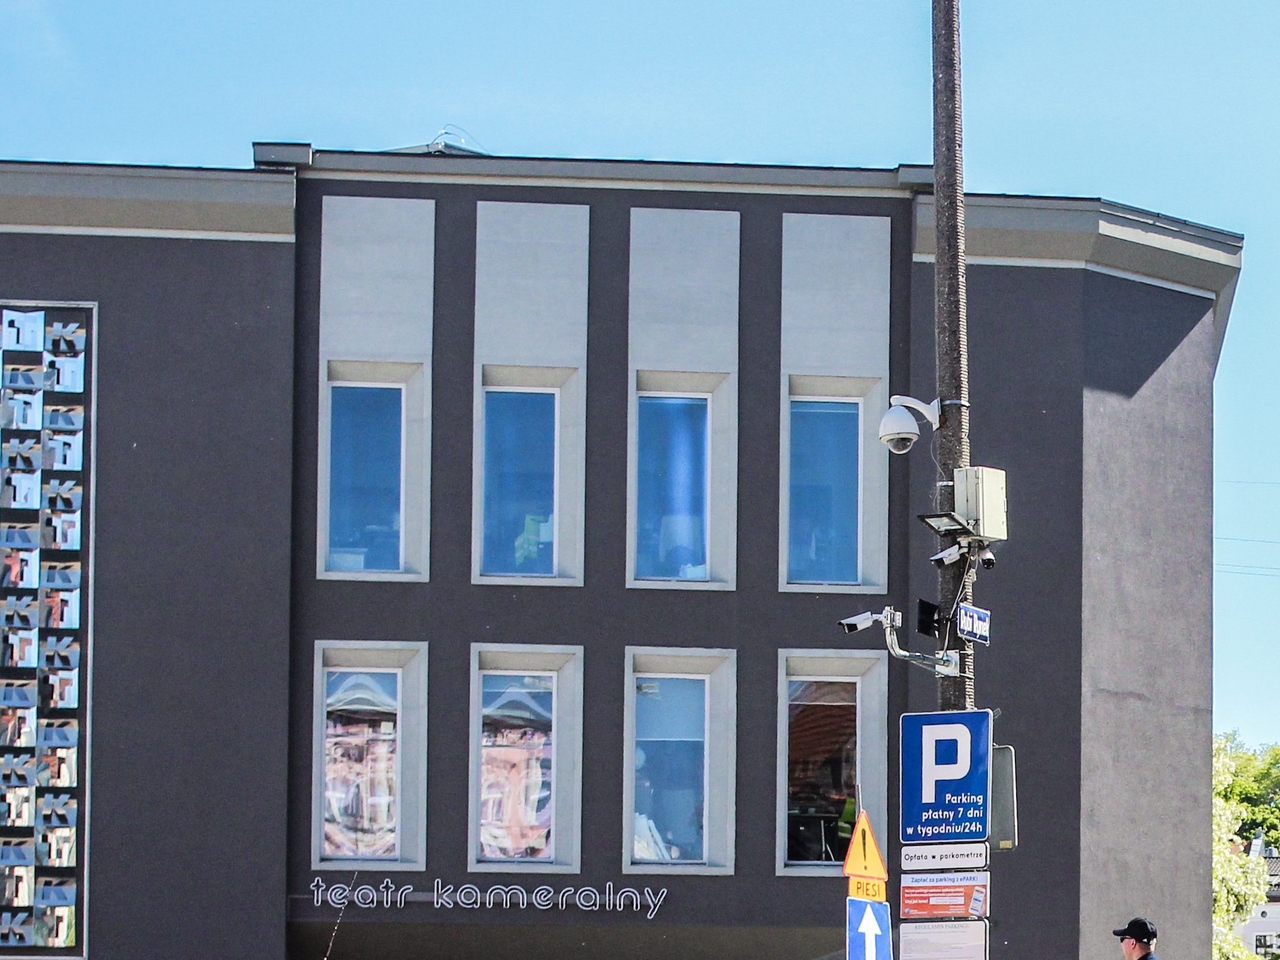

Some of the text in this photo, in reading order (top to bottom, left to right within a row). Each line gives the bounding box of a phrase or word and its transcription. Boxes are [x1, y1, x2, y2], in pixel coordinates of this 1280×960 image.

[921, 724, 972, 803] P
[945, 793, 983, 806] Parking
[922, 806, 983, 822] płatny 7 dni
[906, 821, 983, 837] w tygodniu/24h
[904, 853, 928, 863] Opłata
[939, 851, 983, 861] parkometrze
[310, 876, 668, 919] teatr kameralny
[857, 882, 881, 898] PIESI
